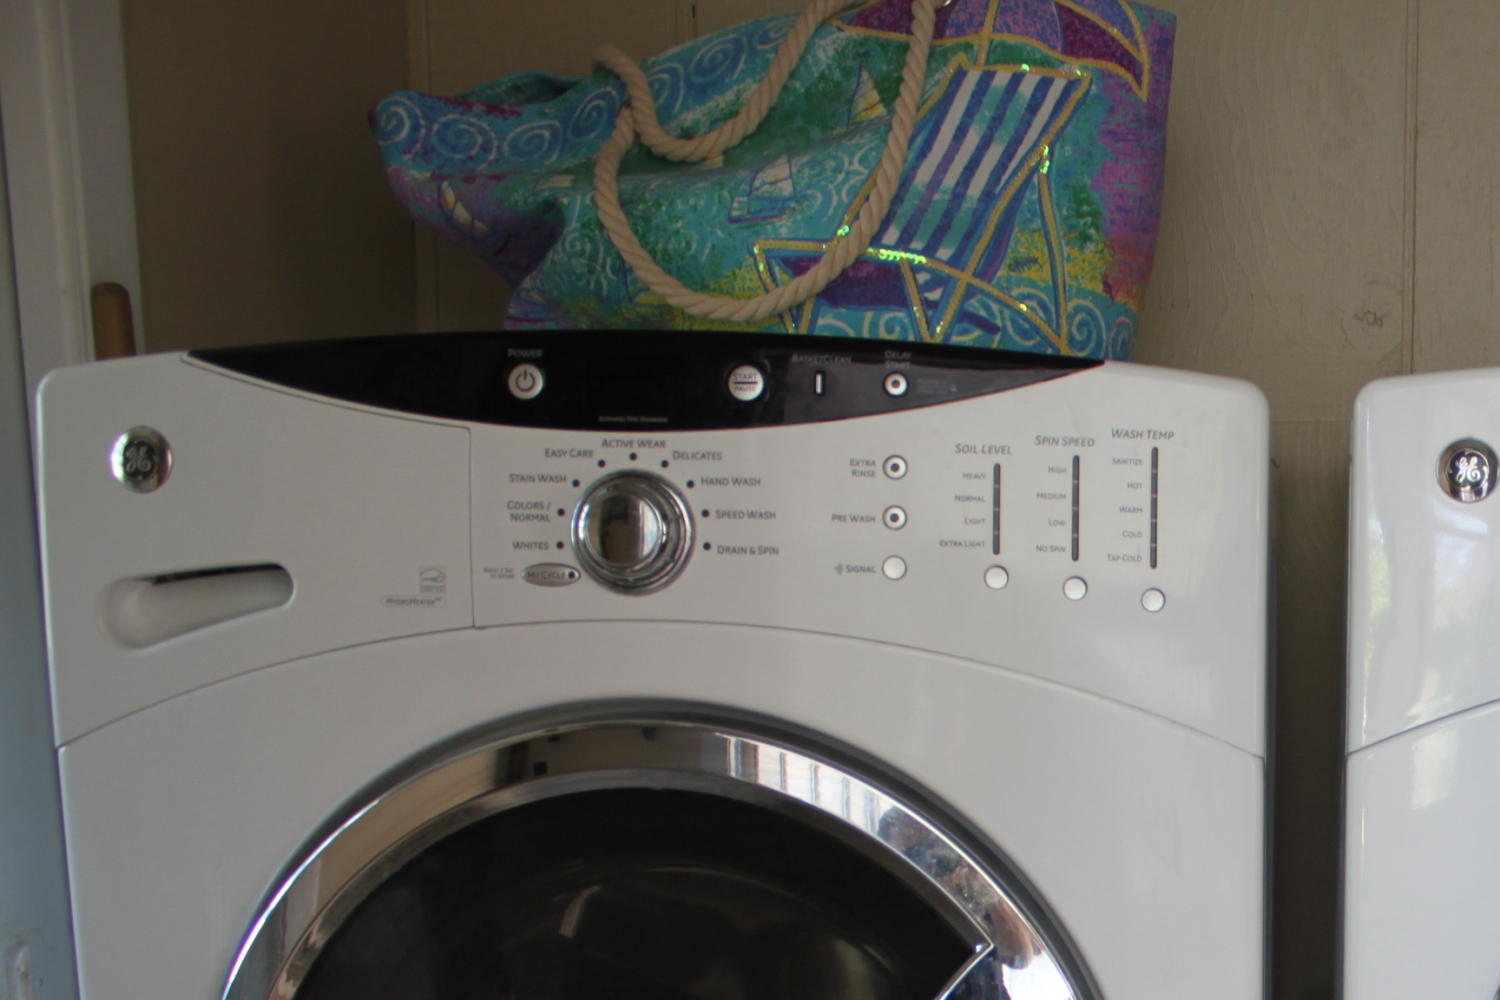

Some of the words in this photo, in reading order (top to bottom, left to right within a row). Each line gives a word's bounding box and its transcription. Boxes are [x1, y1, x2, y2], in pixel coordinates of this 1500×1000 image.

[507, 349, 543, 358] POWER
[733, 372, 758, 380] START
[1111, 428, 1143, 440] WASH
[1146, 429, 1174, 441] TEMP
[601, 439, 634, 449] ACTIVE
[637, 439, 666, 449] WEAR
[1035, 435, 1059, 447] SPIN
[1061, 436, 1095, 448] SPEED
[545, 449, 567, 459] EASY
[569, 449, 594, 459] CARE
[955, 443, 979, 455] SOIL
[981, 444, 1013, 456] LEVEL
[673, 450, 722, 460] DELICATES
[850, 458, 876, 467] EXTRA
[851, 469, 876, 478] RINSE
[508, 474, 535, 483] STAIN
[537, 474, 567, 484] WASH
[701, 477, 728, 487] HAND
[731, 477, 761, 487] WASH
[507, 501, 544, 511] COLORS
[1119, 506, 1143, 514] WARM
[510, 513, 550, 523] NORMAL
[715, 510, 744, 520] SPEED
[746, 510, 776, 520] WASH
[832, 514, 848, 523] PRE
[850, 514, 876, 523] WASH
[964, 517, 986, 526] LIGHT
[1048, 519, 1066, 527] LOW
[1122, 530, 1142, 538] COLD
[512, 541, 549, 551] WHITES
[939, 540, 963, 548] EXTRA
[964, 540, 986, 549] LIGHT
[1049, 545, 1066, 553] SPIN
[717, 546, 747, 556] DRAIN
[749, 546, 756, 555] &
[758, 546, 779, 556] SPIN
[1107, 554, 1121, 562] TAP
[1122, 554, 1142, 563] COLD
[846, 565, 876, 574] SIGNAL
